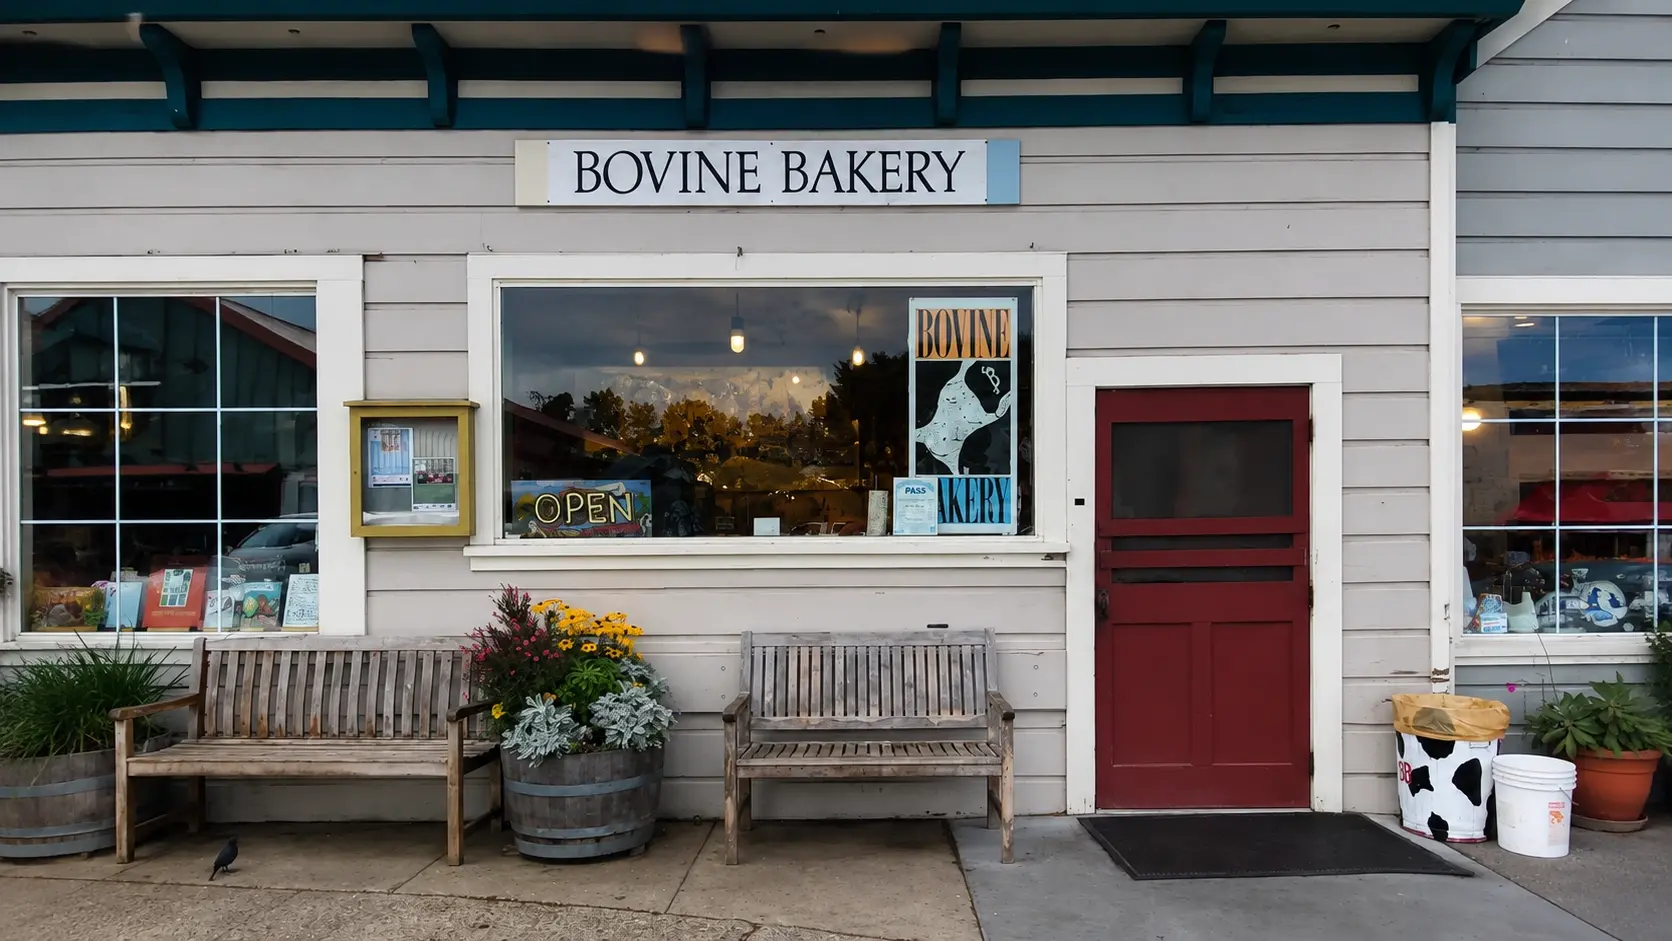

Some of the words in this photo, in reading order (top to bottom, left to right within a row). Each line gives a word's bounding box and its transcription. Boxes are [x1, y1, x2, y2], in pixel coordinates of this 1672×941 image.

[574, 150, 760, 194] BOVINE
[781, 150, 965, 194] BAKERY
[916, 309, 1010, 358] BOVINE
[535, 492, 633, 524] OPEN
[905, 487, 926, 495] PASS
[938, 477, 1010, 523] AKERY
